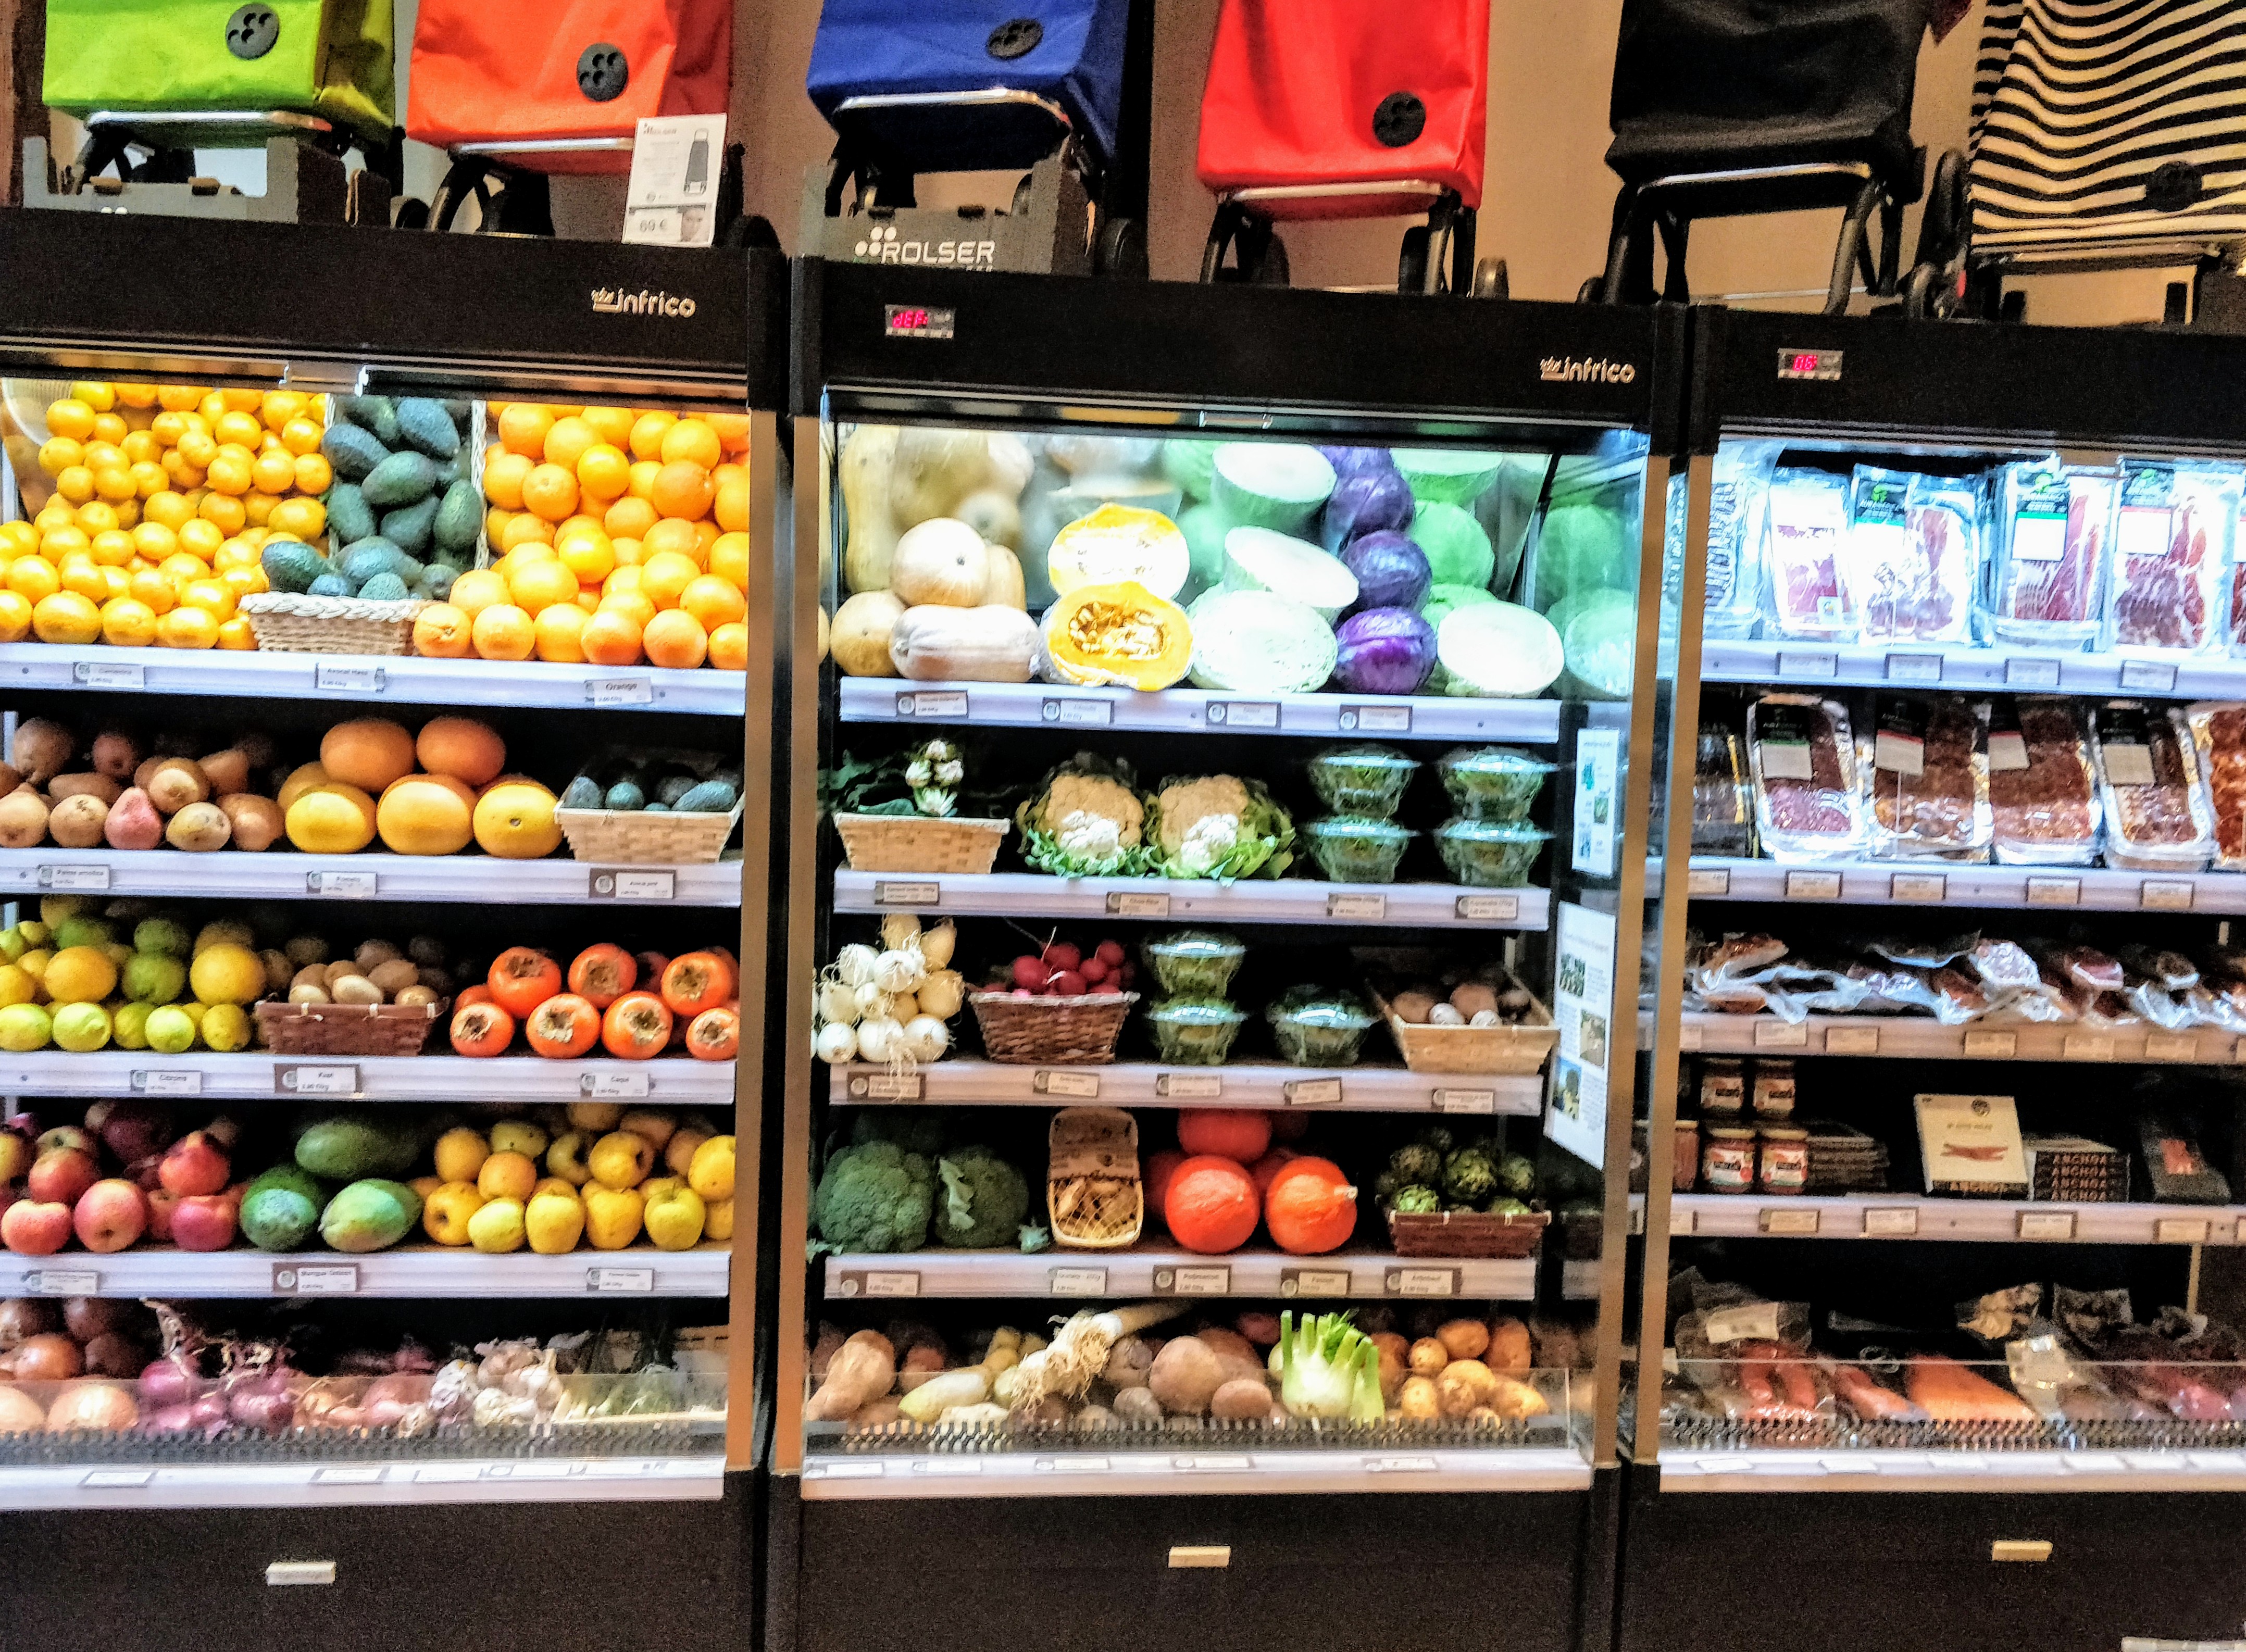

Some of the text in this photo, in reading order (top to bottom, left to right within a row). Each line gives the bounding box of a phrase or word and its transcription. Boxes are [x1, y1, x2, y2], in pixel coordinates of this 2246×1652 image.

[881, 240, 996, 265] ROLSER
[593, 287, 696, 318] infrico
[1541, 356, 1636, 383] infrico
